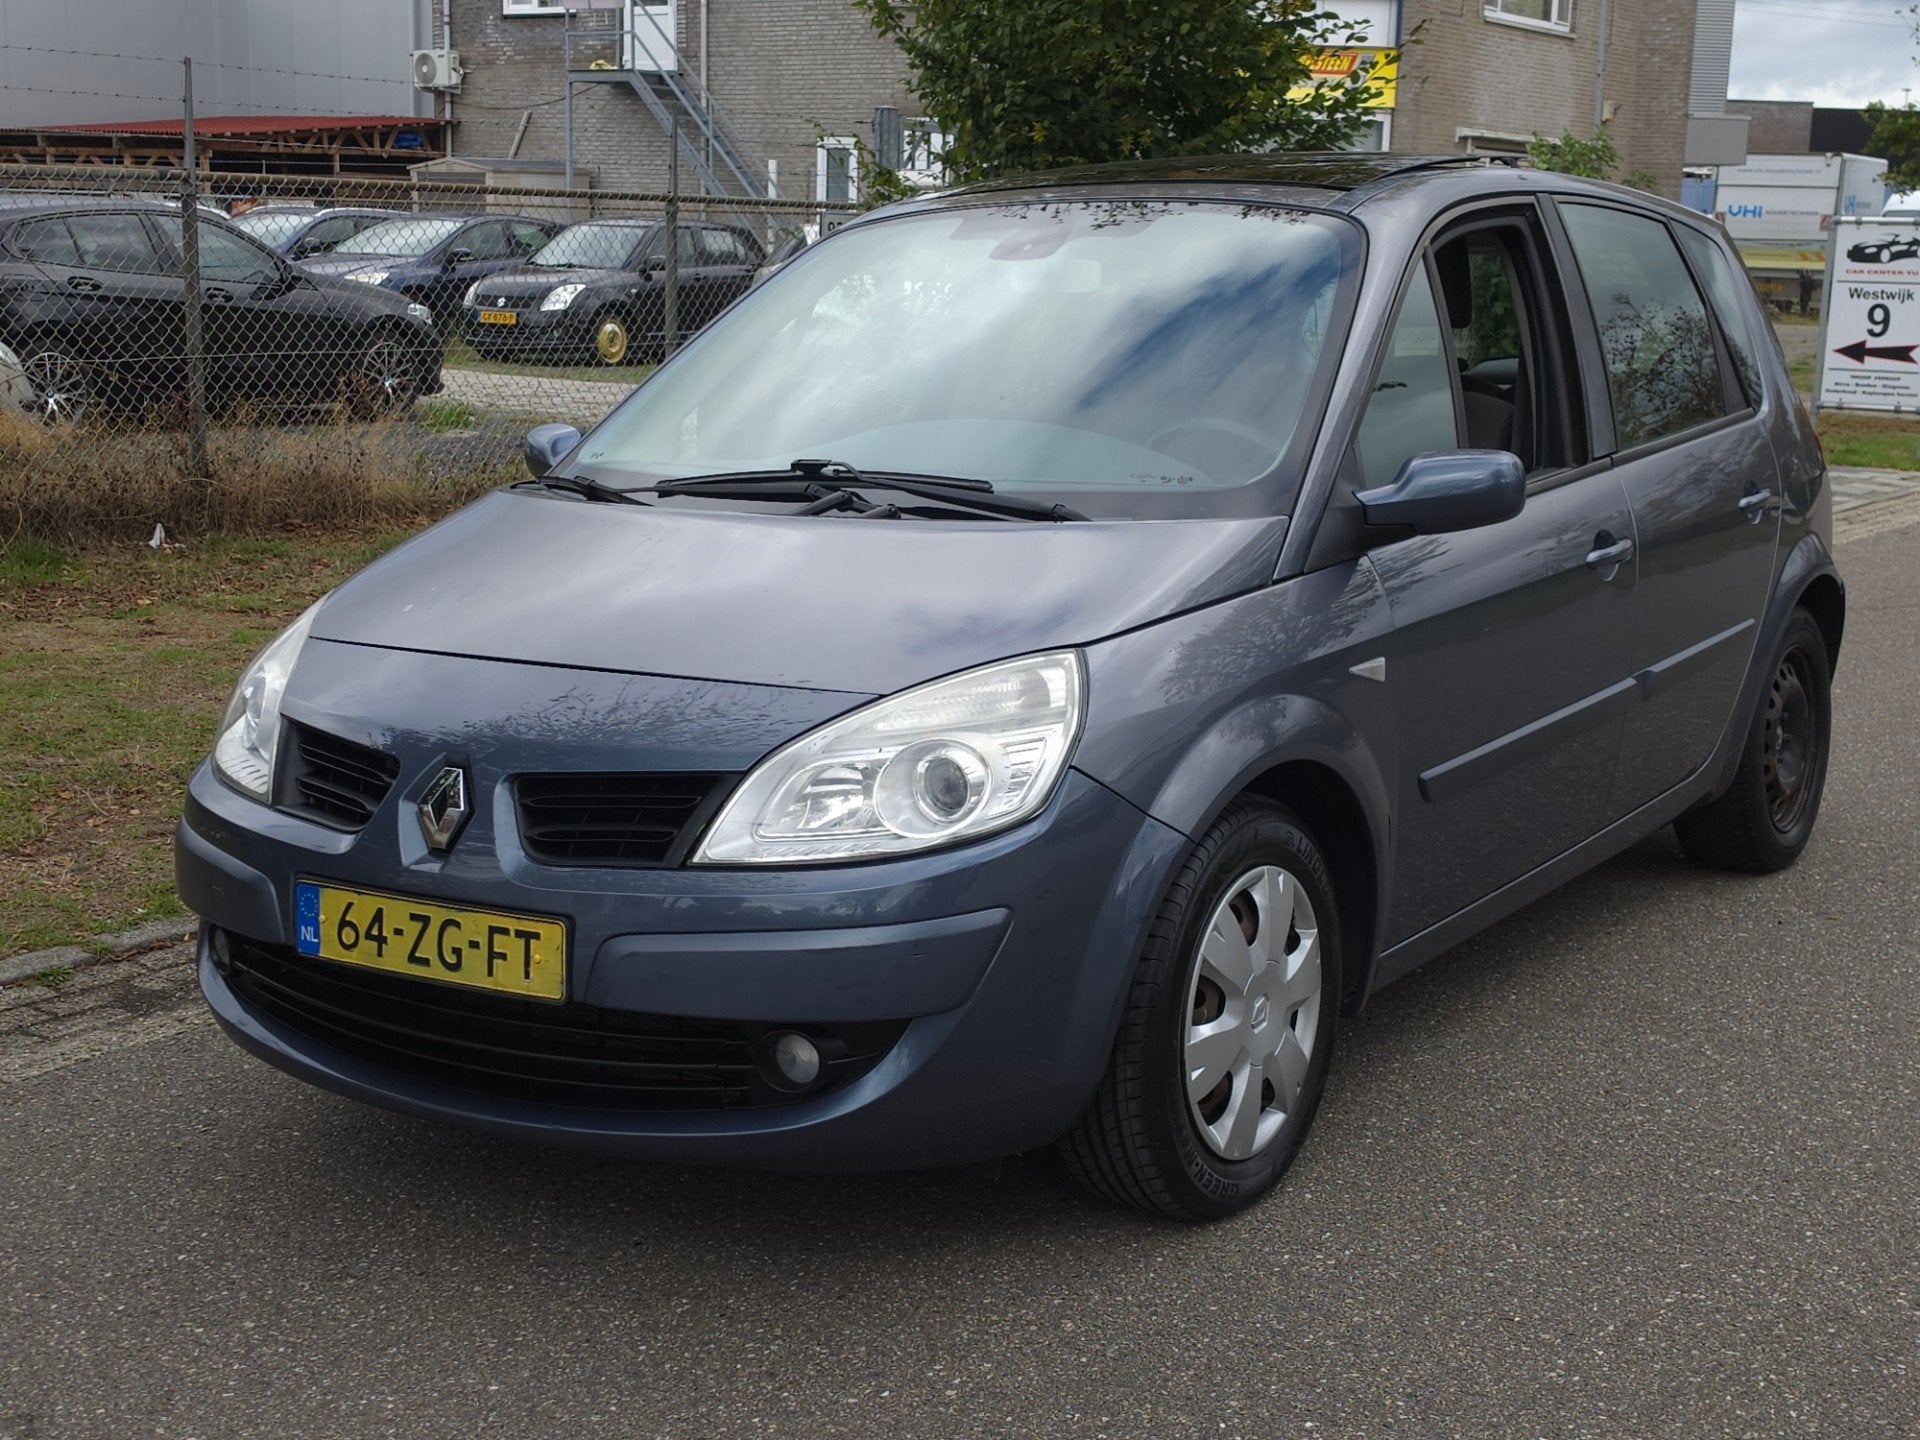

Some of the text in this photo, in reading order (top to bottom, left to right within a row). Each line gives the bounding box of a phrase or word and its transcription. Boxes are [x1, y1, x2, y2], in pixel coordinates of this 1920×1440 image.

[1848, 286, 1915, 304] Westwijk
[1867, 303, 1891, 338] 9
[301, 925, 319, 943] NL
[336, 901, 541, 983] 64-ZG-FT
